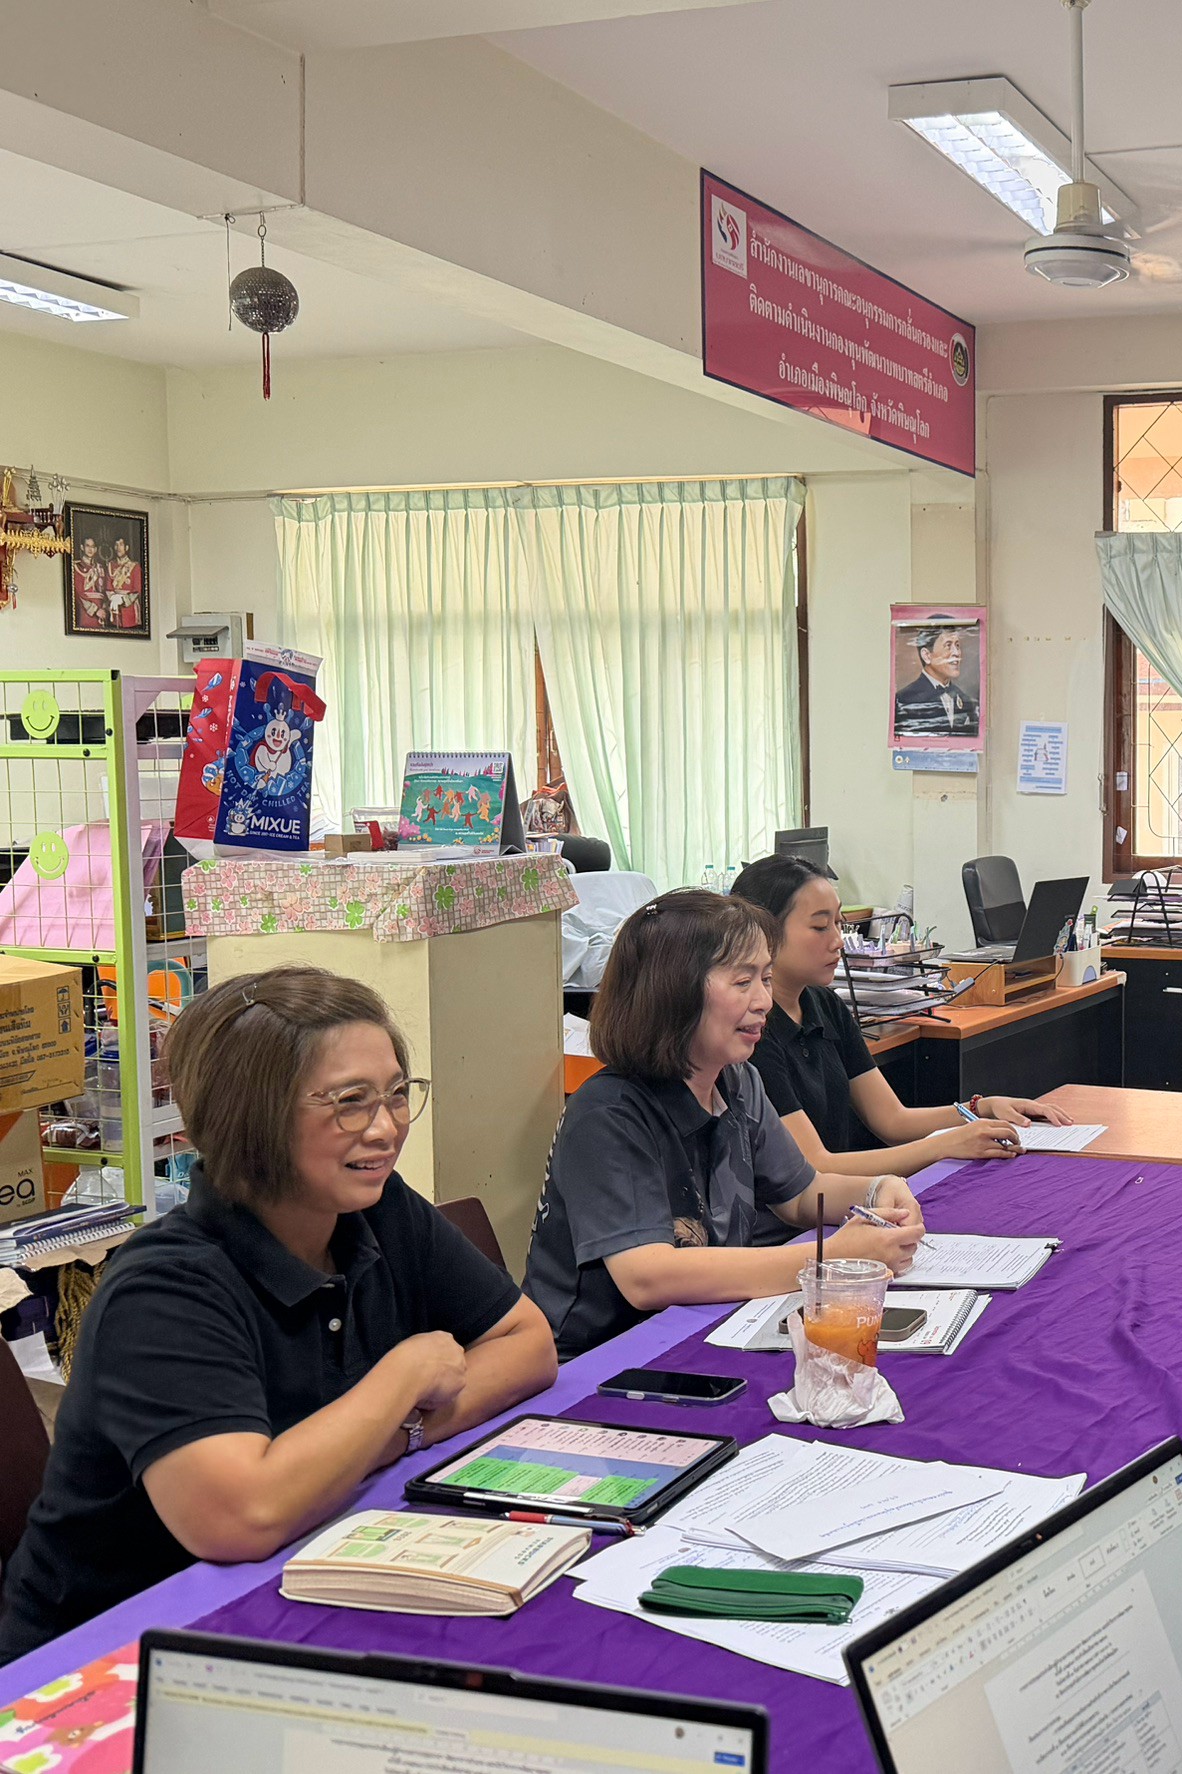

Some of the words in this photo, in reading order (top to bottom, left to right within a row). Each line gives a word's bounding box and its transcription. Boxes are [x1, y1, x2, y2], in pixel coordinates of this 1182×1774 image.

[778, 353, 867, 418] อำเภอเมืองพิษณุโลก
[870, 393, 930, 443] จังหวัดพิษณุโลก
[226, 769, 241, 789] HOT
[261, 795, 295, 807] CHILLED
[296, 781, 310, 797] TEA
[250, 815, 301, 834] MIXUE
[17, 1168, 33, 1178] MAX
